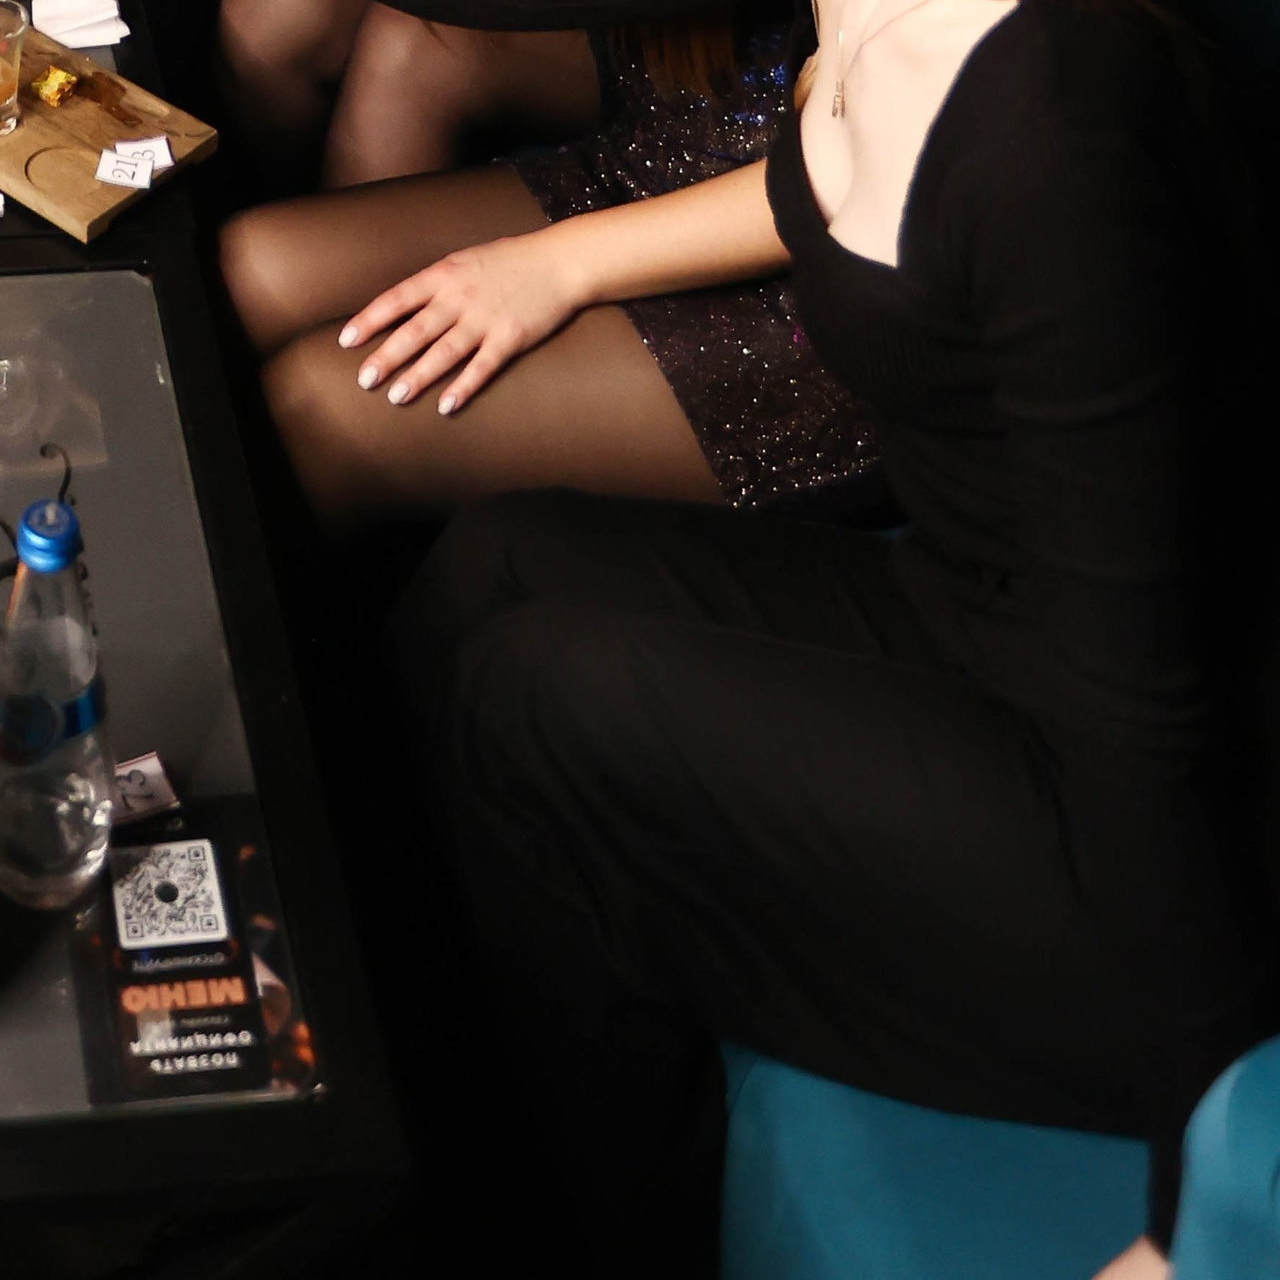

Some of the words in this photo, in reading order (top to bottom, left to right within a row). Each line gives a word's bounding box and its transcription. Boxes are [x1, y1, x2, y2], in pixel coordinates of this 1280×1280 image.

[111, 159, 138, 181] 21
[120, 976, 247, 1015] МЕНЮ
[129, 1029, 253, 1057] ОФИЦИАНТА
[149, 1051, 241, 1074] ПОЗВАТЬ
